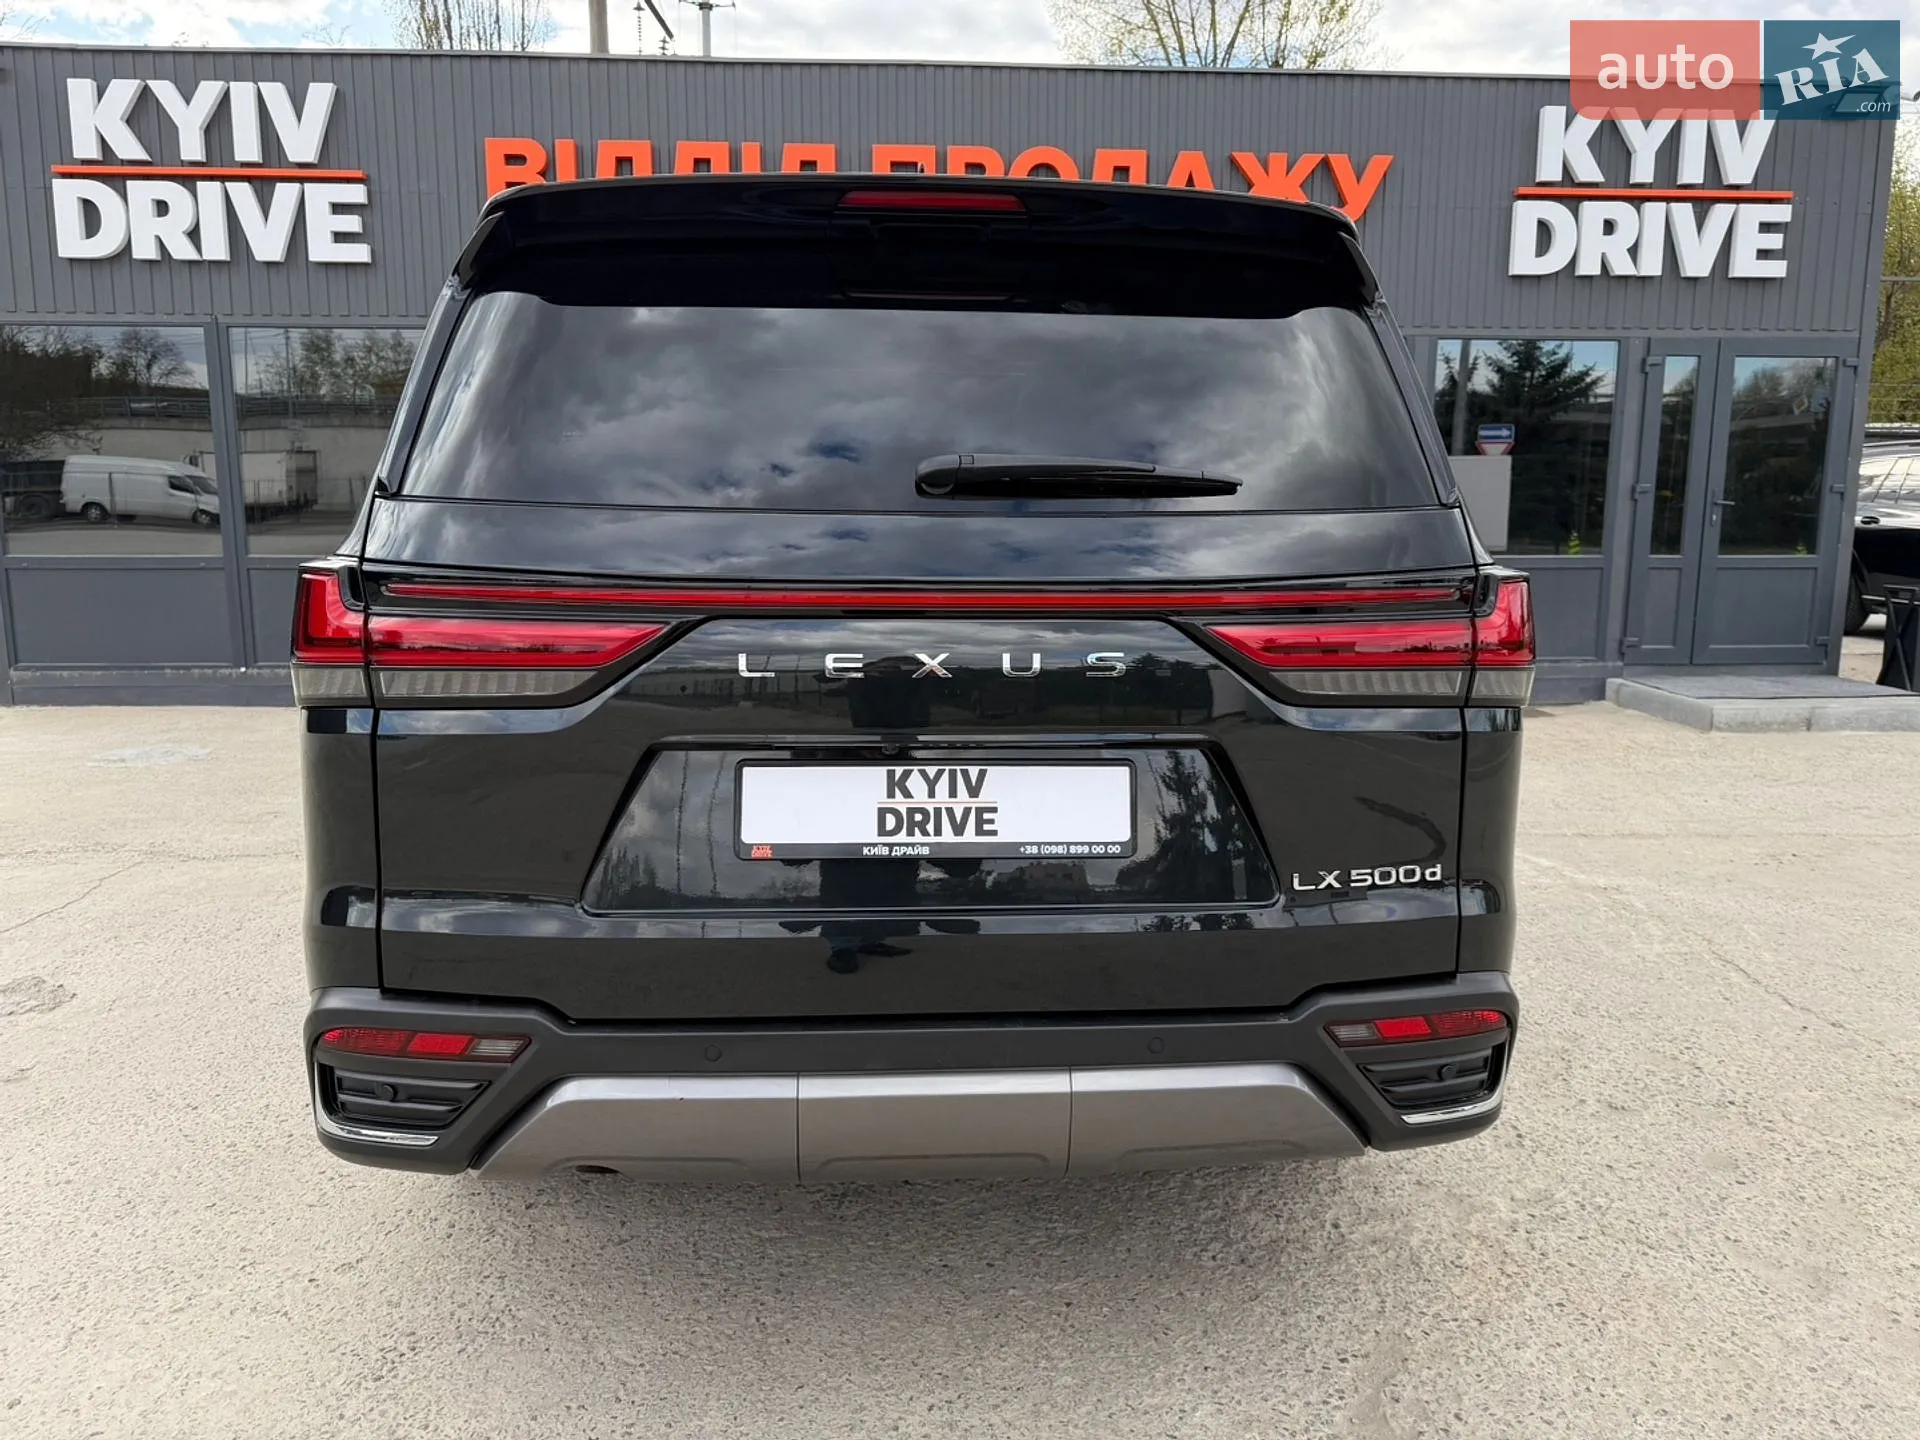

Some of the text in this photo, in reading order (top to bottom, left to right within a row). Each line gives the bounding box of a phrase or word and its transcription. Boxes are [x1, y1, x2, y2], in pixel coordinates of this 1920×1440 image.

[66, 77, 337, 164] KYIV
[1535, 104, 1778, 186] KYIV
[51, 178, 372, 264] DRIVE
[1508, 200, 1792, 279] DRIVE
[737, 652, 1127, 679] LEXUS
[886, 768, 988, 799] KYIV
[876, 806, 999, 837] DRIVE
[863, 844, 930, 857] КИЇВ ДРАЙВ
[1292, 863, 1442, 891] LX 500d
